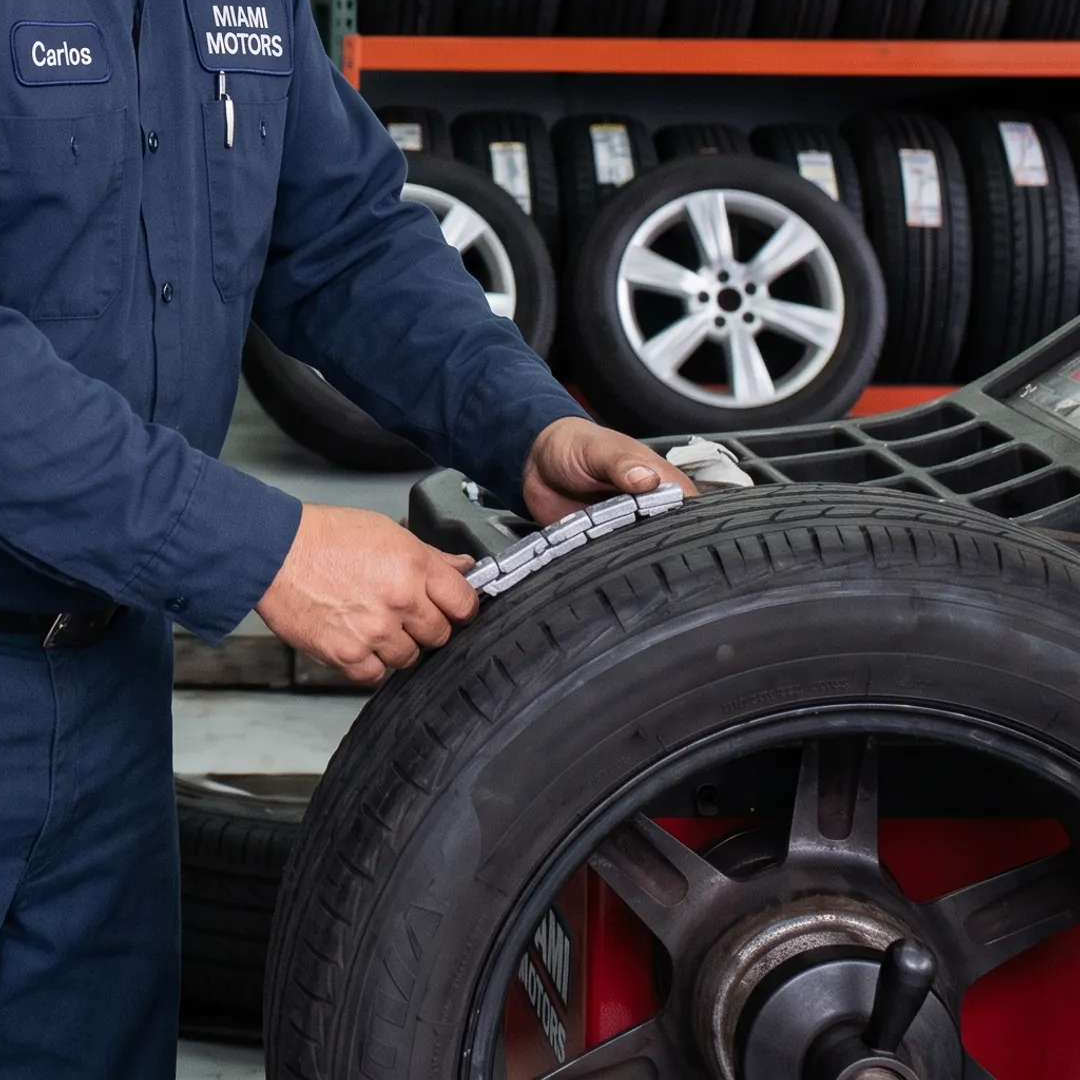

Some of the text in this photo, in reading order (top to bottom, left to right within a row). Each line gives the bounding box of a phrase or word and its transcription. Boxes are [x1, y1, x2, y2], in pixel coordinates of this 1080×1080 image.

[212, 5, 268, 29] MIAMI
[31, 40, 92, 67] Carlos
[206, 31, 284, 58] MOTORS
[533, 907, 570, 1007] AMI
